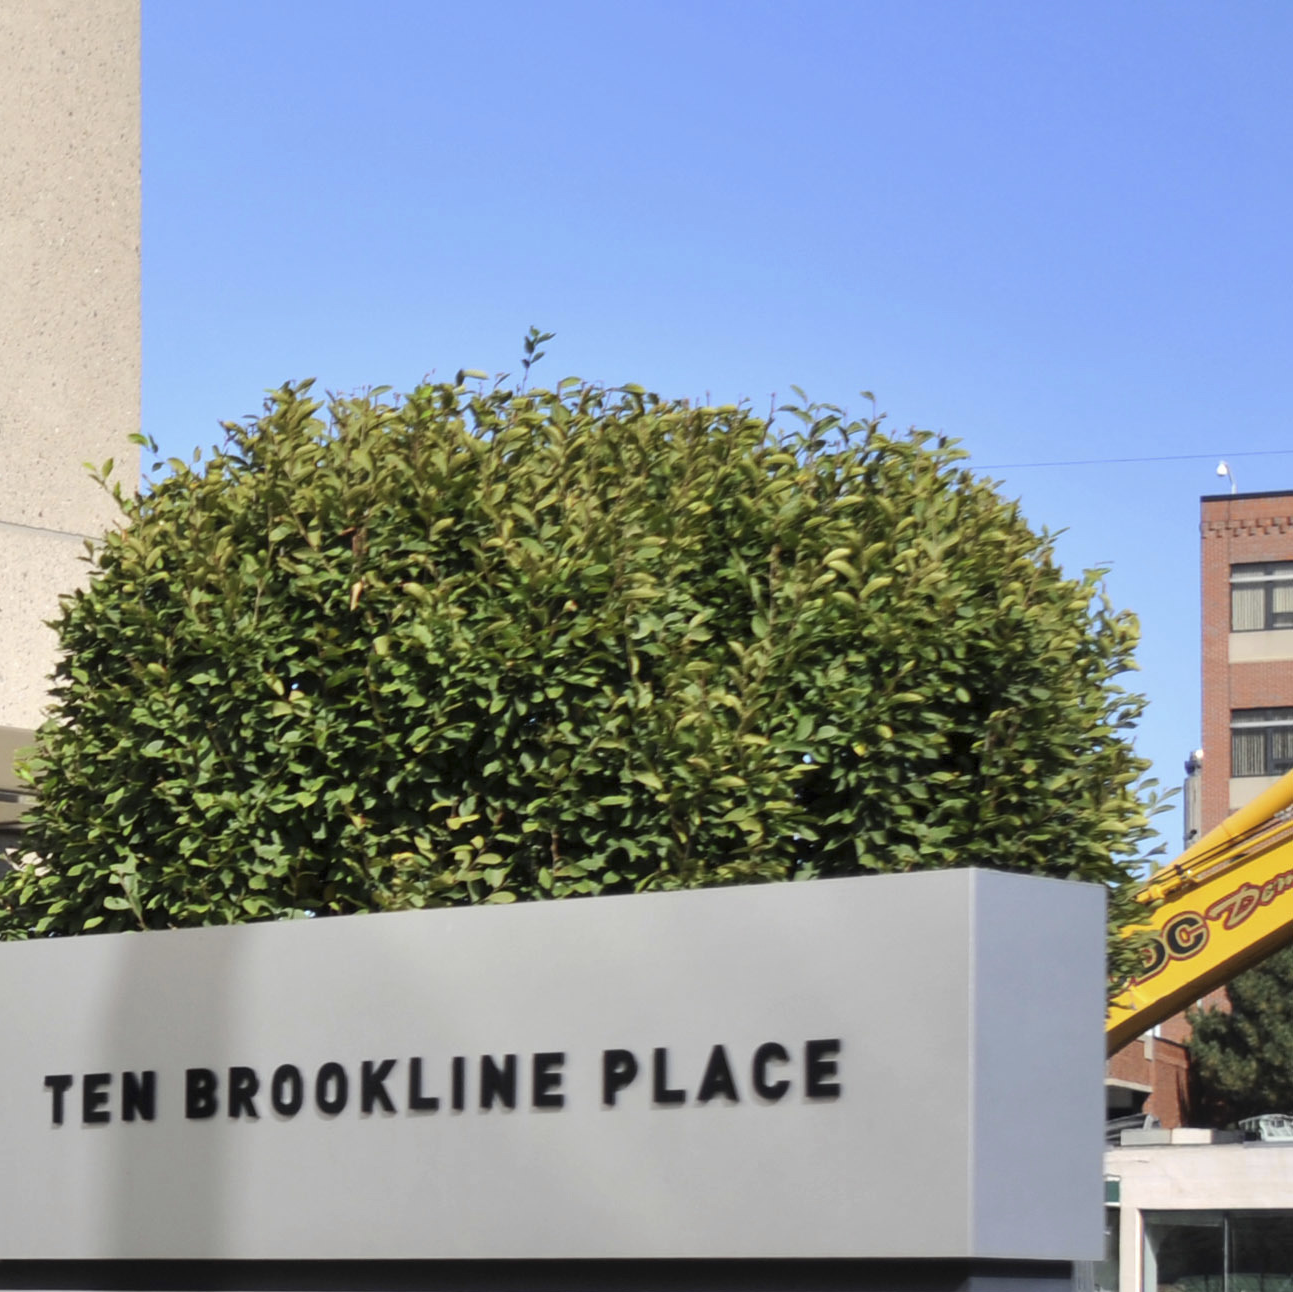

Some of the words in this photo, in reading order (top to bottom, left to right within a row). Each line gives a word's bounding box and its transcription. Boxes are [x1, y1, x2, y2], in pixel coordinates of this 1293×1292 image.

[43, 1069, 159, 1127] TEN
[184, 1051, 567, 1122] BROOKLINE
[601, 1038, 844, 1108] PLACE
